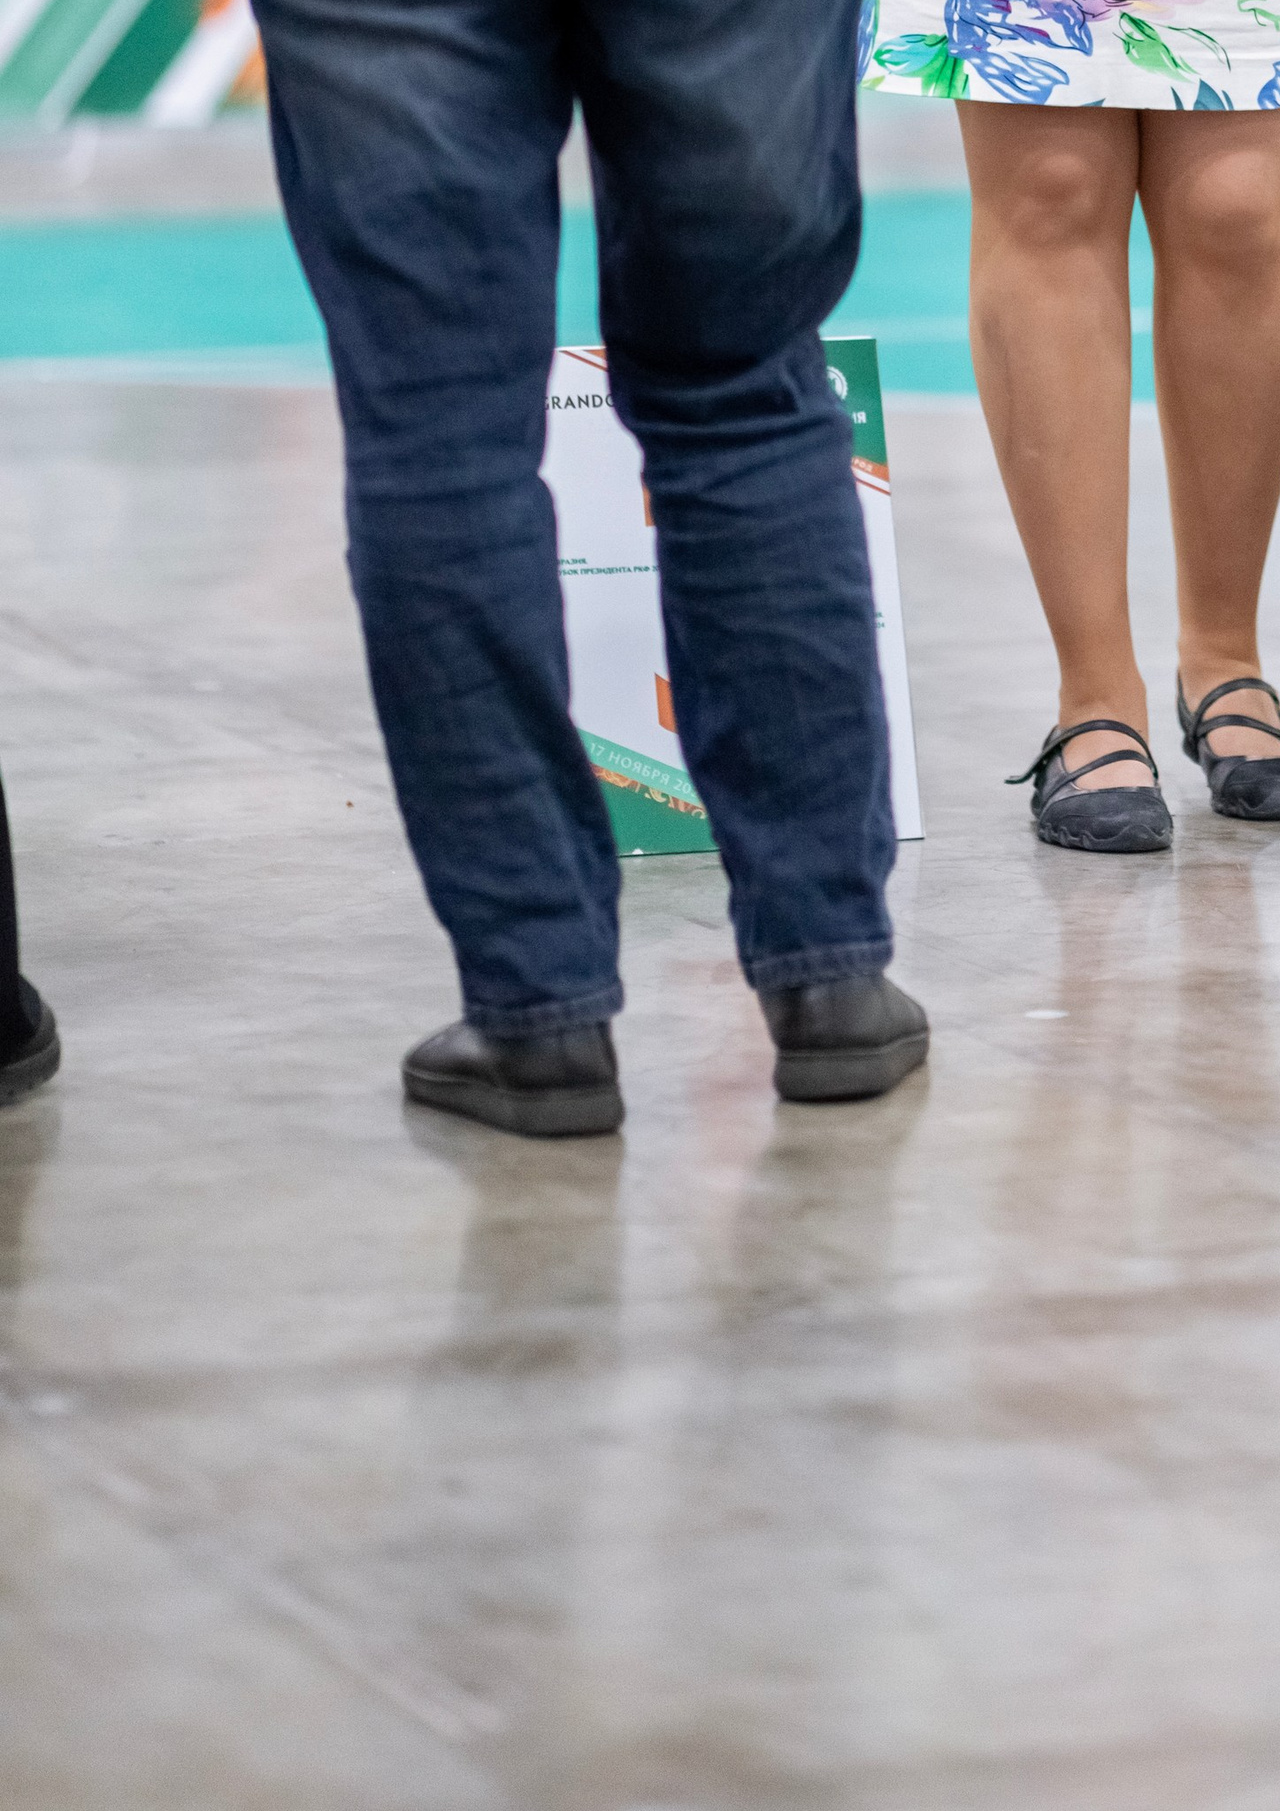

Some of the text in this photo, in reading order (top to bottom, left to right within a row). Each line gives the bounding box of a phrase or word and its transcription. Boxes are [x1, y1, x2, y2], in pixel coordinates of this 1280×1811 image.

[545, 394, 614, 409] RANDO
[580, 566, 631, 575] ПРЕЗИДЕНТА
[608, 751, 670, 786] НОЯБРЯ
[674, 778, 697, 799] 20
